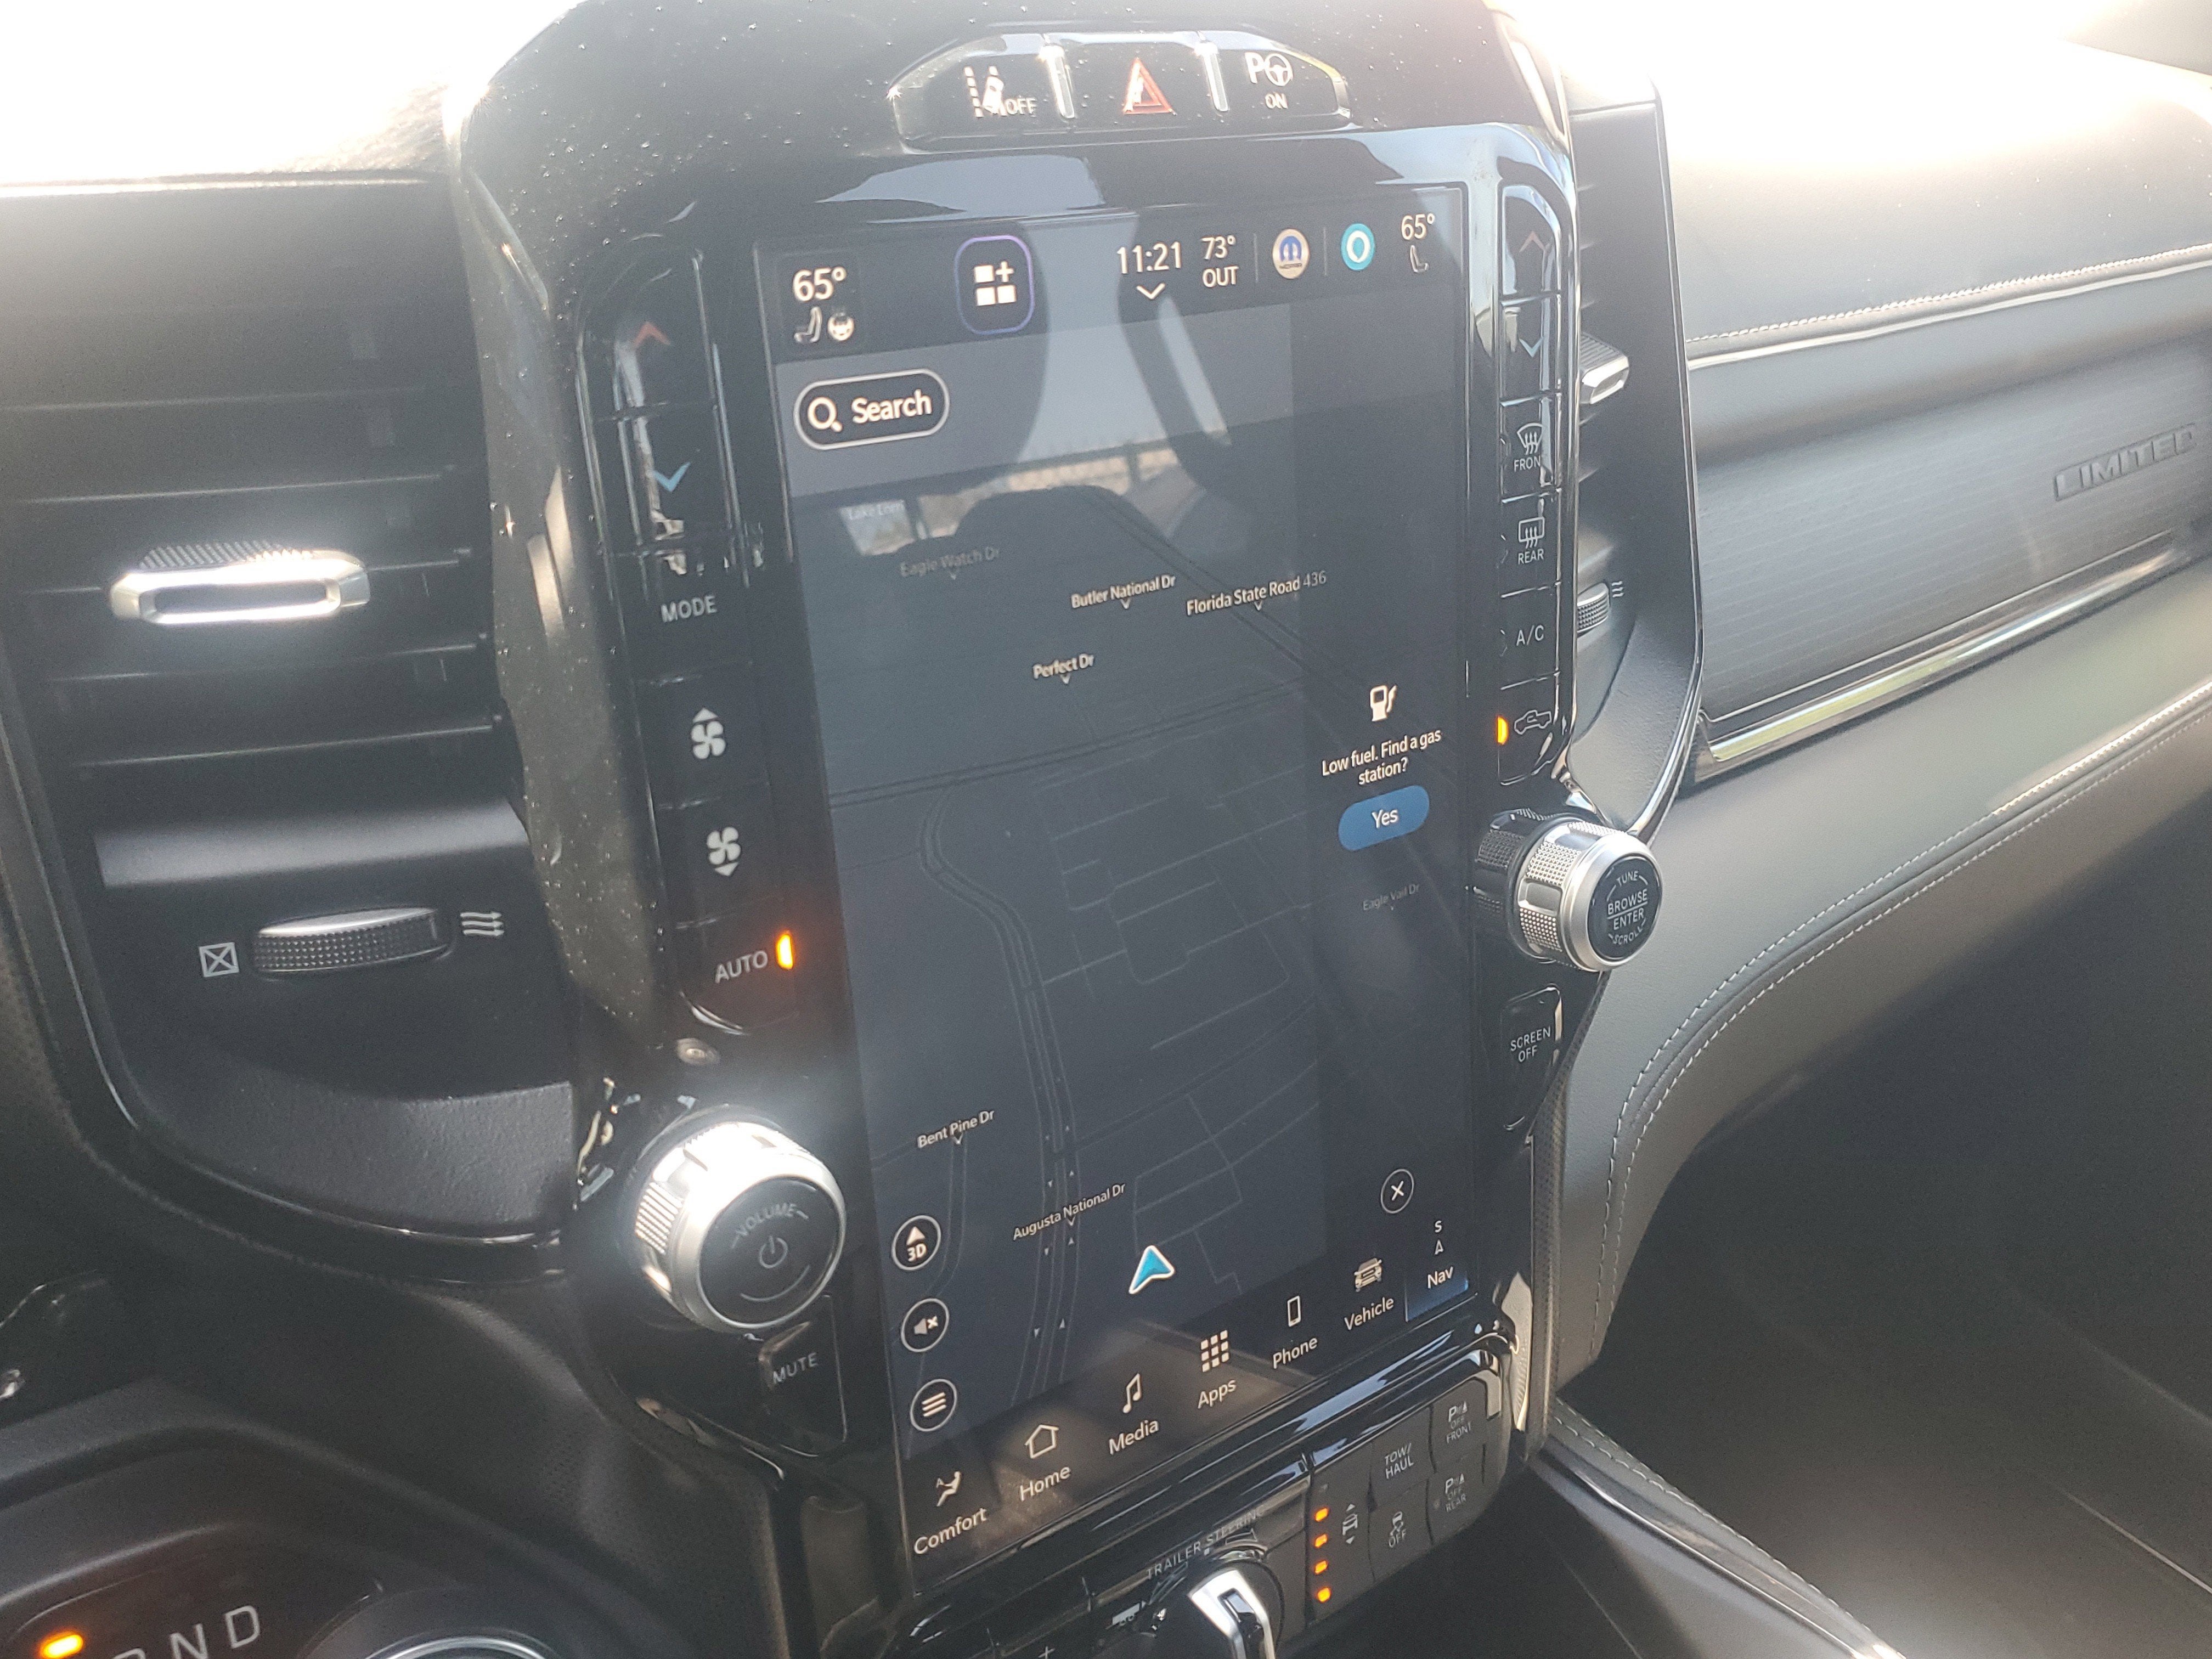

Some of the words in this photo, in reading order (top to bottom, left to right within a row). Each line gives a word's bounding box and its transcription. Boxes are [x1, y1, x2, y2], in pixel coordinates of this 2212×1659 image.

[1006, 98, 1037, 114] OFF
[1265, 93, 1288, 109] ON
[1401, 213, 1435, 240] 65°
[1118, 241, 1182, 274] 11:21
[1201, 235, 1235, 260] 73°
[793, 266, 847, 301] 65°
[1203, 266, 1239, 287] OUT
[852, 390, 932, 424] Search
[1514, 455, 1542, 472] FRON
[900, 558, 938, 576] Eagle
[986, 546, 998, 560] Dr
[1517, 549, 1544, 565] REAR
[1071, 590, 1108, 608] Butler
[1110, 577, 1160, 600] National
[1162, 574, 1176, 589] Dr
[1186, 594, 1232, 616] Florida
[1233, 585, 1267, 605] State
[1269, 577, 1300, 599] Road
[1304, 570, 1327, 588] 436
[661, 595, 718, 623] MODE
[1516, 624, 1544, 646] A/C
[1032, 657, 1077, 679] Perfect
[1079, 653, 1094, 669] Dr
[1322, 757, 1348, 776] Low
[1351, 746, 1378, 766] fuel.
[1381, 735, 1408, 758] Find
[1410, 737, 1418, 749] a
[1419, 729, 1442, 751] gas
[1358, 757, 1408, 785] station?
[1372, 809, 1399, 828] Yes
[1617, 871, 1639, 887] TUNE
[1363, 895, 1389, 911] Eagle
[1409, 884, 1419, 894] Dr
[1608, 889, 1647, 915] BROWSE
[1613, 908, 1644, 930] ENTER
[1613, 925, 1644, 945] SCROLL
[715, 951, 768, 984] AUTO
[1510, 1025, 1551, 1052] SCREEN
[1517, 1044, 1538, 1063] OFF
[917, 1128, 948, 1149] Bent
[949, 1115, 978, 1136] Pine
[979, 1108, 995, 1123] Dr
[736, 1203, 797, 1239] VOLUME
[1013, 1211, 1062, 1242] Augusta
[1063, 1188, 1110, 1219] National
[1111, 1182, 1126, 1198] Dr
[1435, 1220, 1442, 1233] S
[907, 1243, 927, 1262] 3D
[1427, 1266, 1454, 1289] Nav
[1344, 1296, 1395, 1331] Vehicle
[1272, 1336, 1318, 1370] Phone
[772, 1351, 819, 1385] MUTE
[1198, 1379, 1237, 1409] Apps
[1109, 1418, 1160, 1455] Media
[1384, 1442, 1412, 1465] TOW/
[1386, 1456, 1414, 1479] HAUL
[1019, 1466, 1071, 1502] Home
[914, 1507, 988, 1555] Comfort
[1388, 1528, 1407, 1548] OFF
[1147, 1541, 1201, 1579] TRAILER
[170, 1624, 208, 1659] N
[224, 1605, 261, 1649] D
